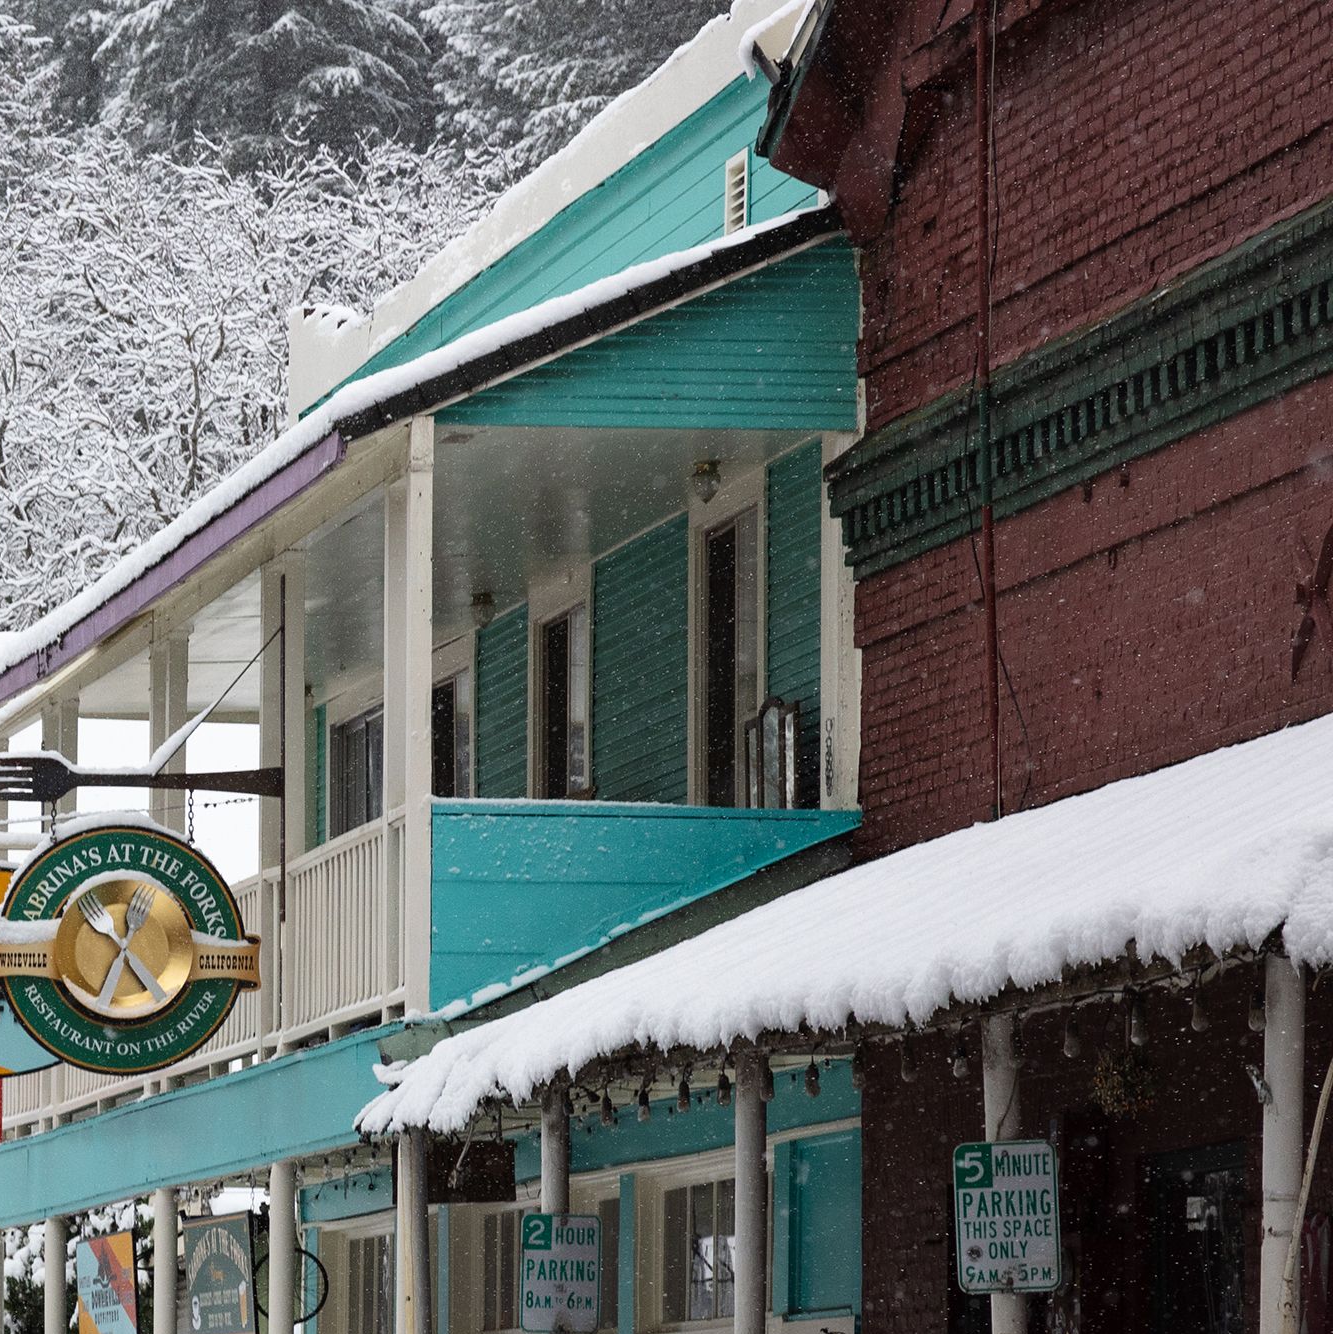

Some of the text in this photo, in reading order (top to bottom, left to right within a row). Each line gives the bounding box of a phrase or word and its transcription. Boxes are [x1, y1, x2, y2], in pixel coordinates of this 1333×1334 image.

[22, 844, 228, 940] ABRINA'S AT THE FORKS
[199, 954, 255, 971] CALIFORNIA
[24, 985, 217, 1055] RESTAURANT ON THE RIVER
[964, 1151, 1051, 1183] 5 MINUTE
[962, 1189, 1052, 1218] PARKING
[528, 1219, 596, 1246] 2 HOUR
[965, 1217, 1053, 1239] THIS SPACE
[988, 1240, 1028, 1260] ONLY
[526, 1259, 596, 1281] PARKING
[94, 1310, 120, 1325] OUTFITTERS
